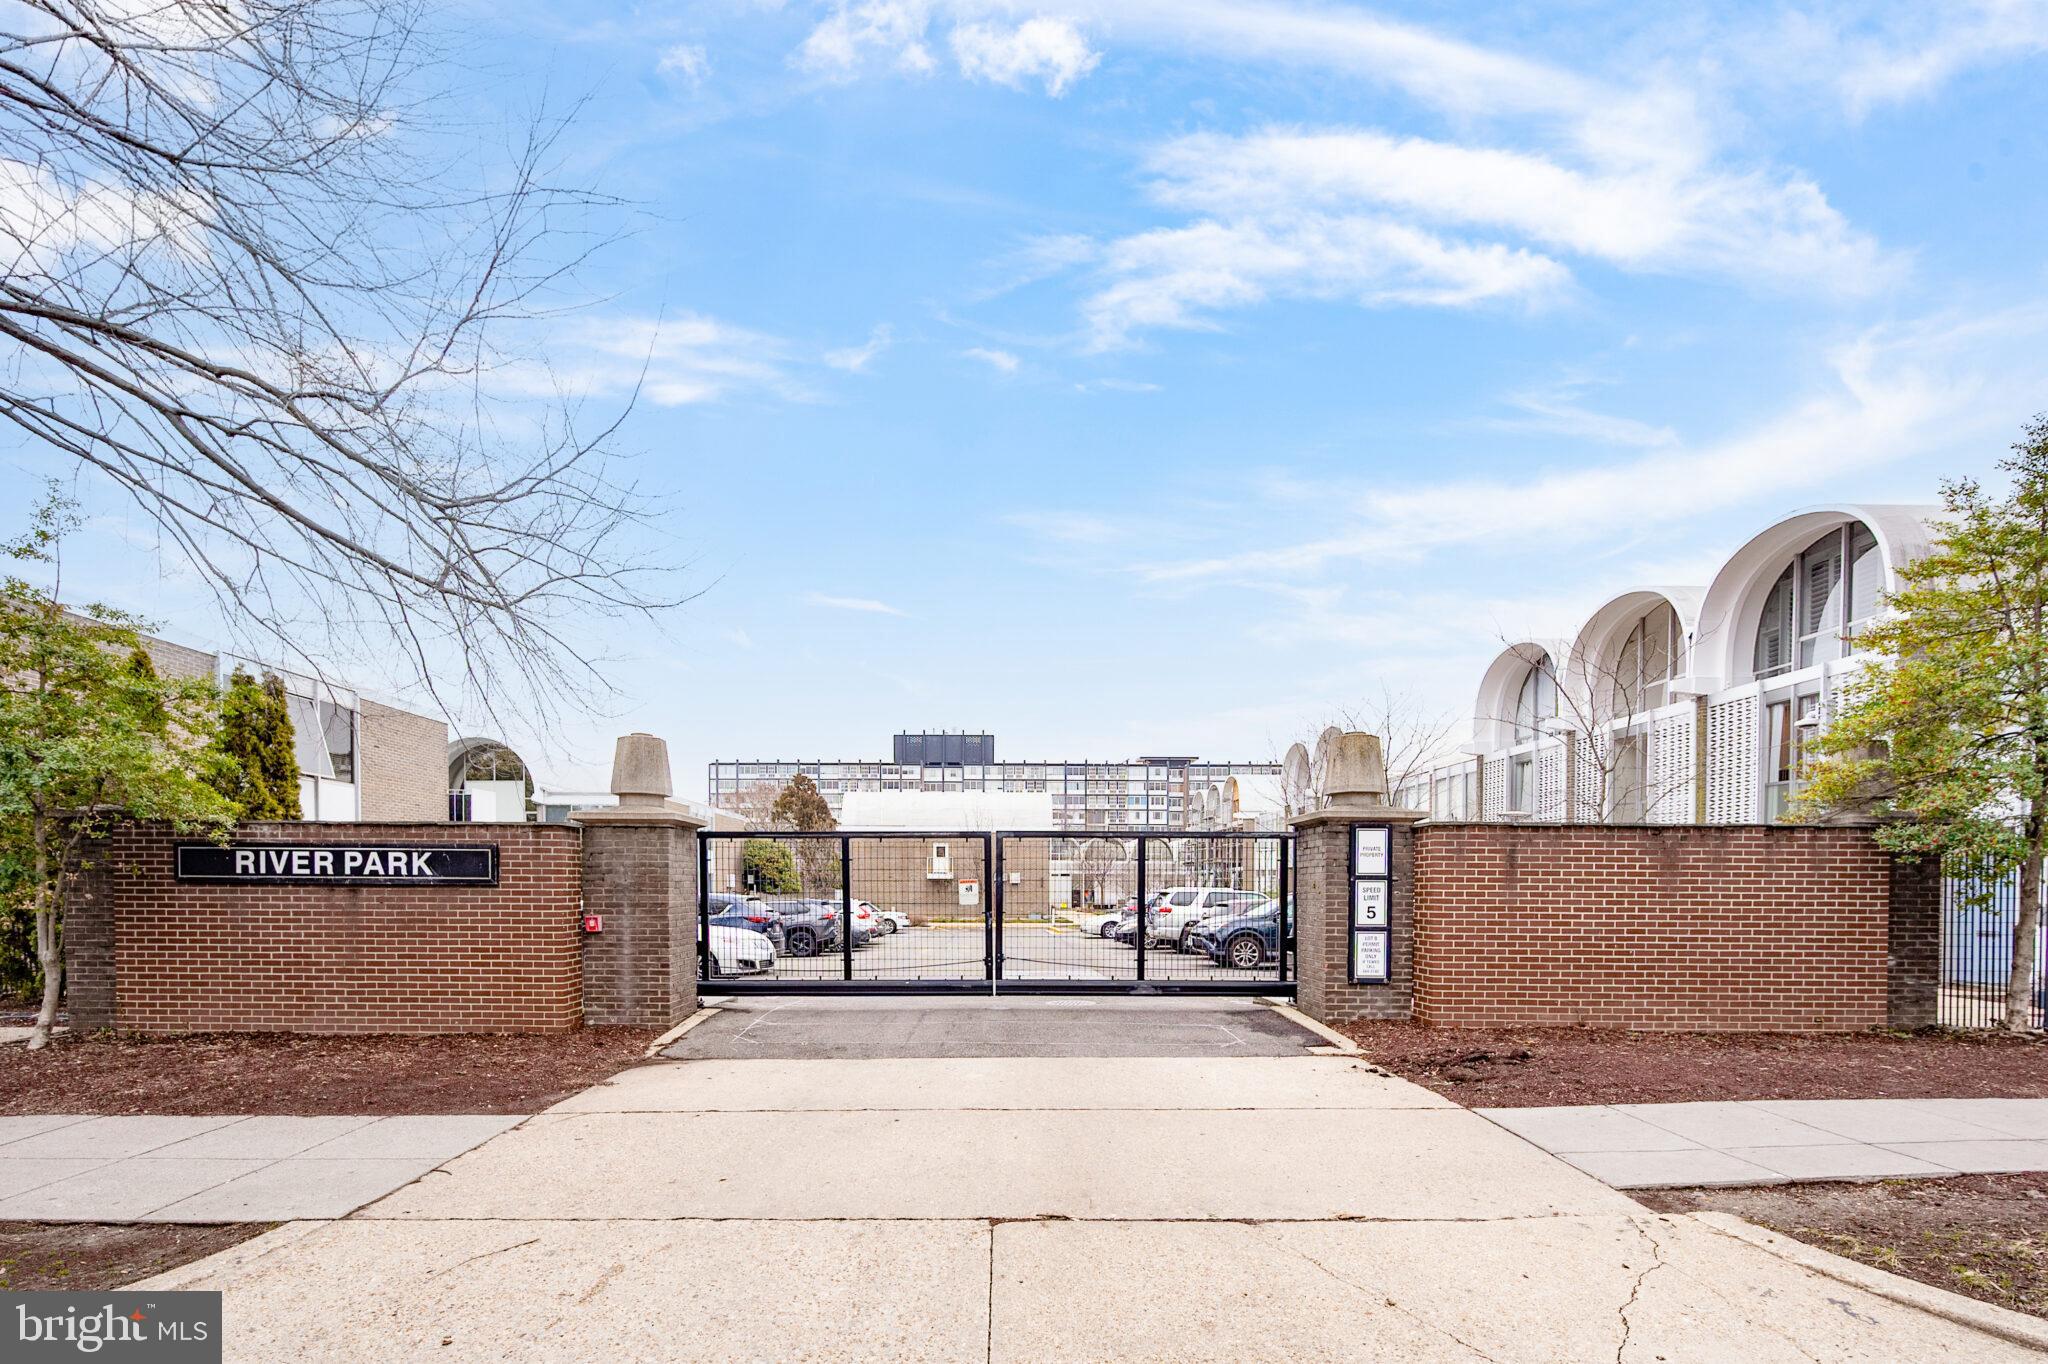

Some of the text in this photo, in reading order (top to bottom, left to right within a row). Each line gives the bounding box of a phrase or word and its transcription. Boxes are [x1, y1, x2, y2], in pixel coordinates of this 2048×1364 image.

[235, 850, 433, 876] RIVER PARK
[1366, 906, 1376, 920] 5
